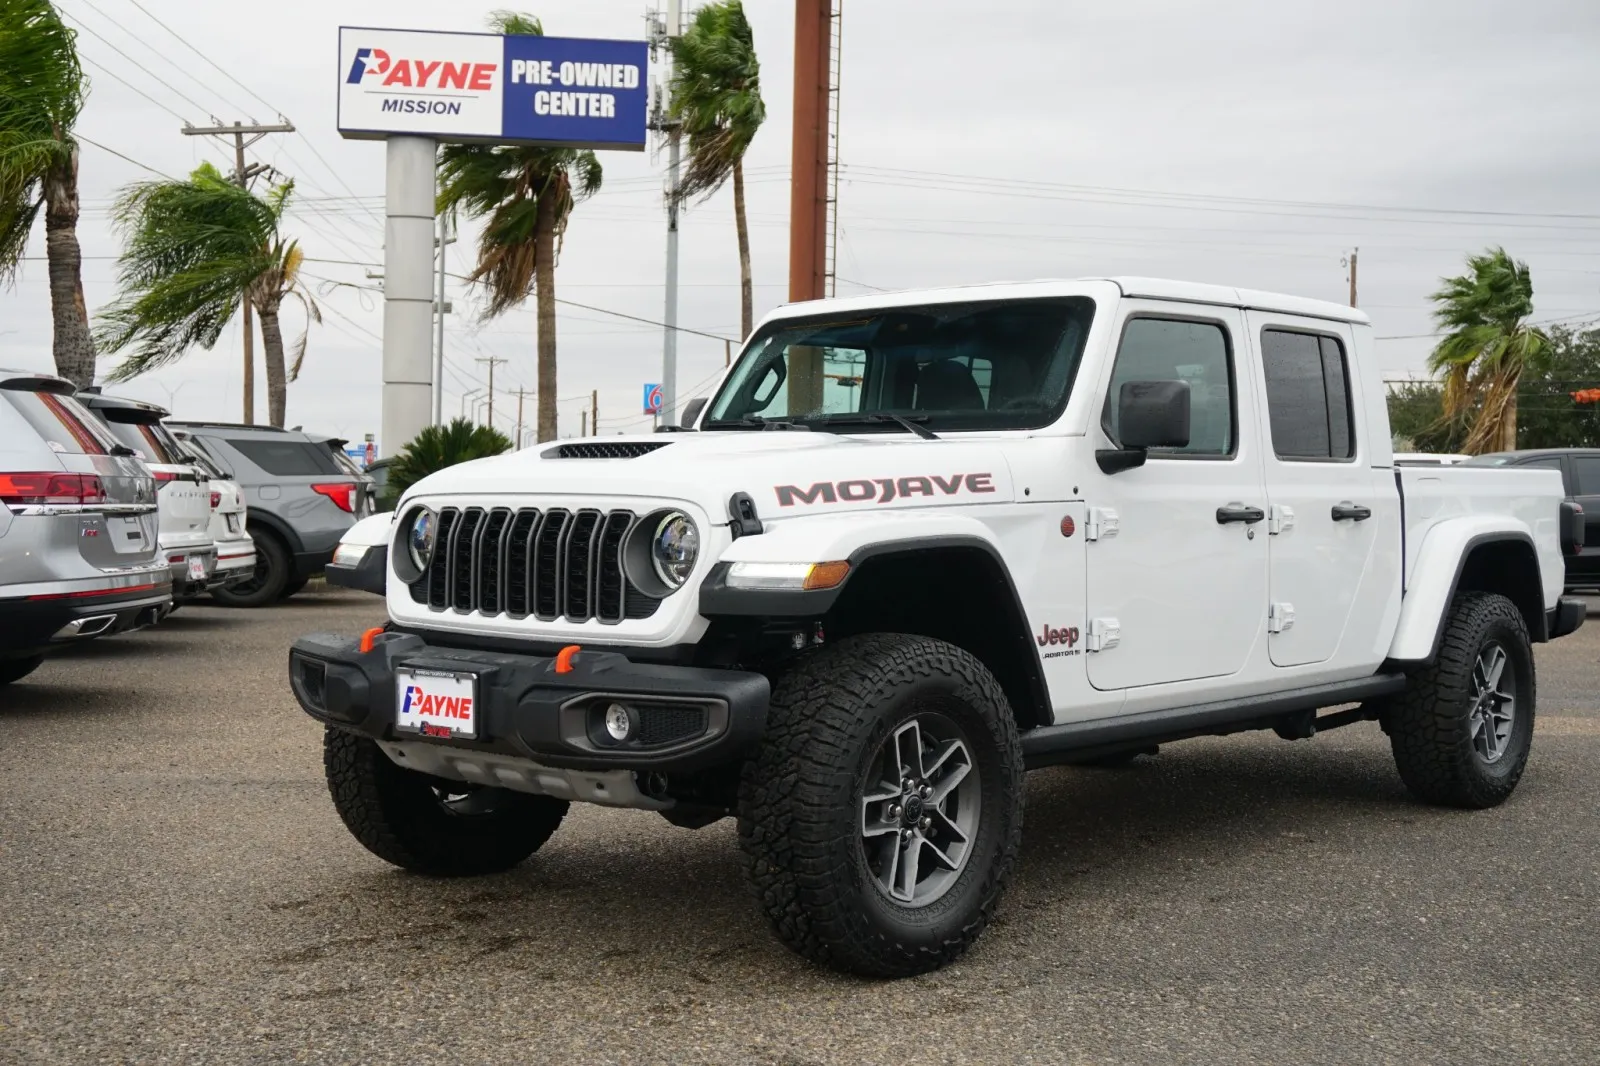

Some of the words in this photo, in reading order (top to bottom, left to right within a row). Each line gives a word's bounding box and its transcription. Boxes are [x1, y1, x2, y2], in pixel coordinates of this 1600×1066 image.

[346, 47, 497, 91] PAYNE
[511, 59, 640, 89] PRE-OWNED
[381, 99, 462, 116] MISSION
[533, 90, 615, 118] CENTER
[648, 384, 664, 410] 6
[774, 473, 996, 507] MOJAVE
[1037, 623, 1080, 648] Jeep
[402, 686, 472, 720] PAYNE
